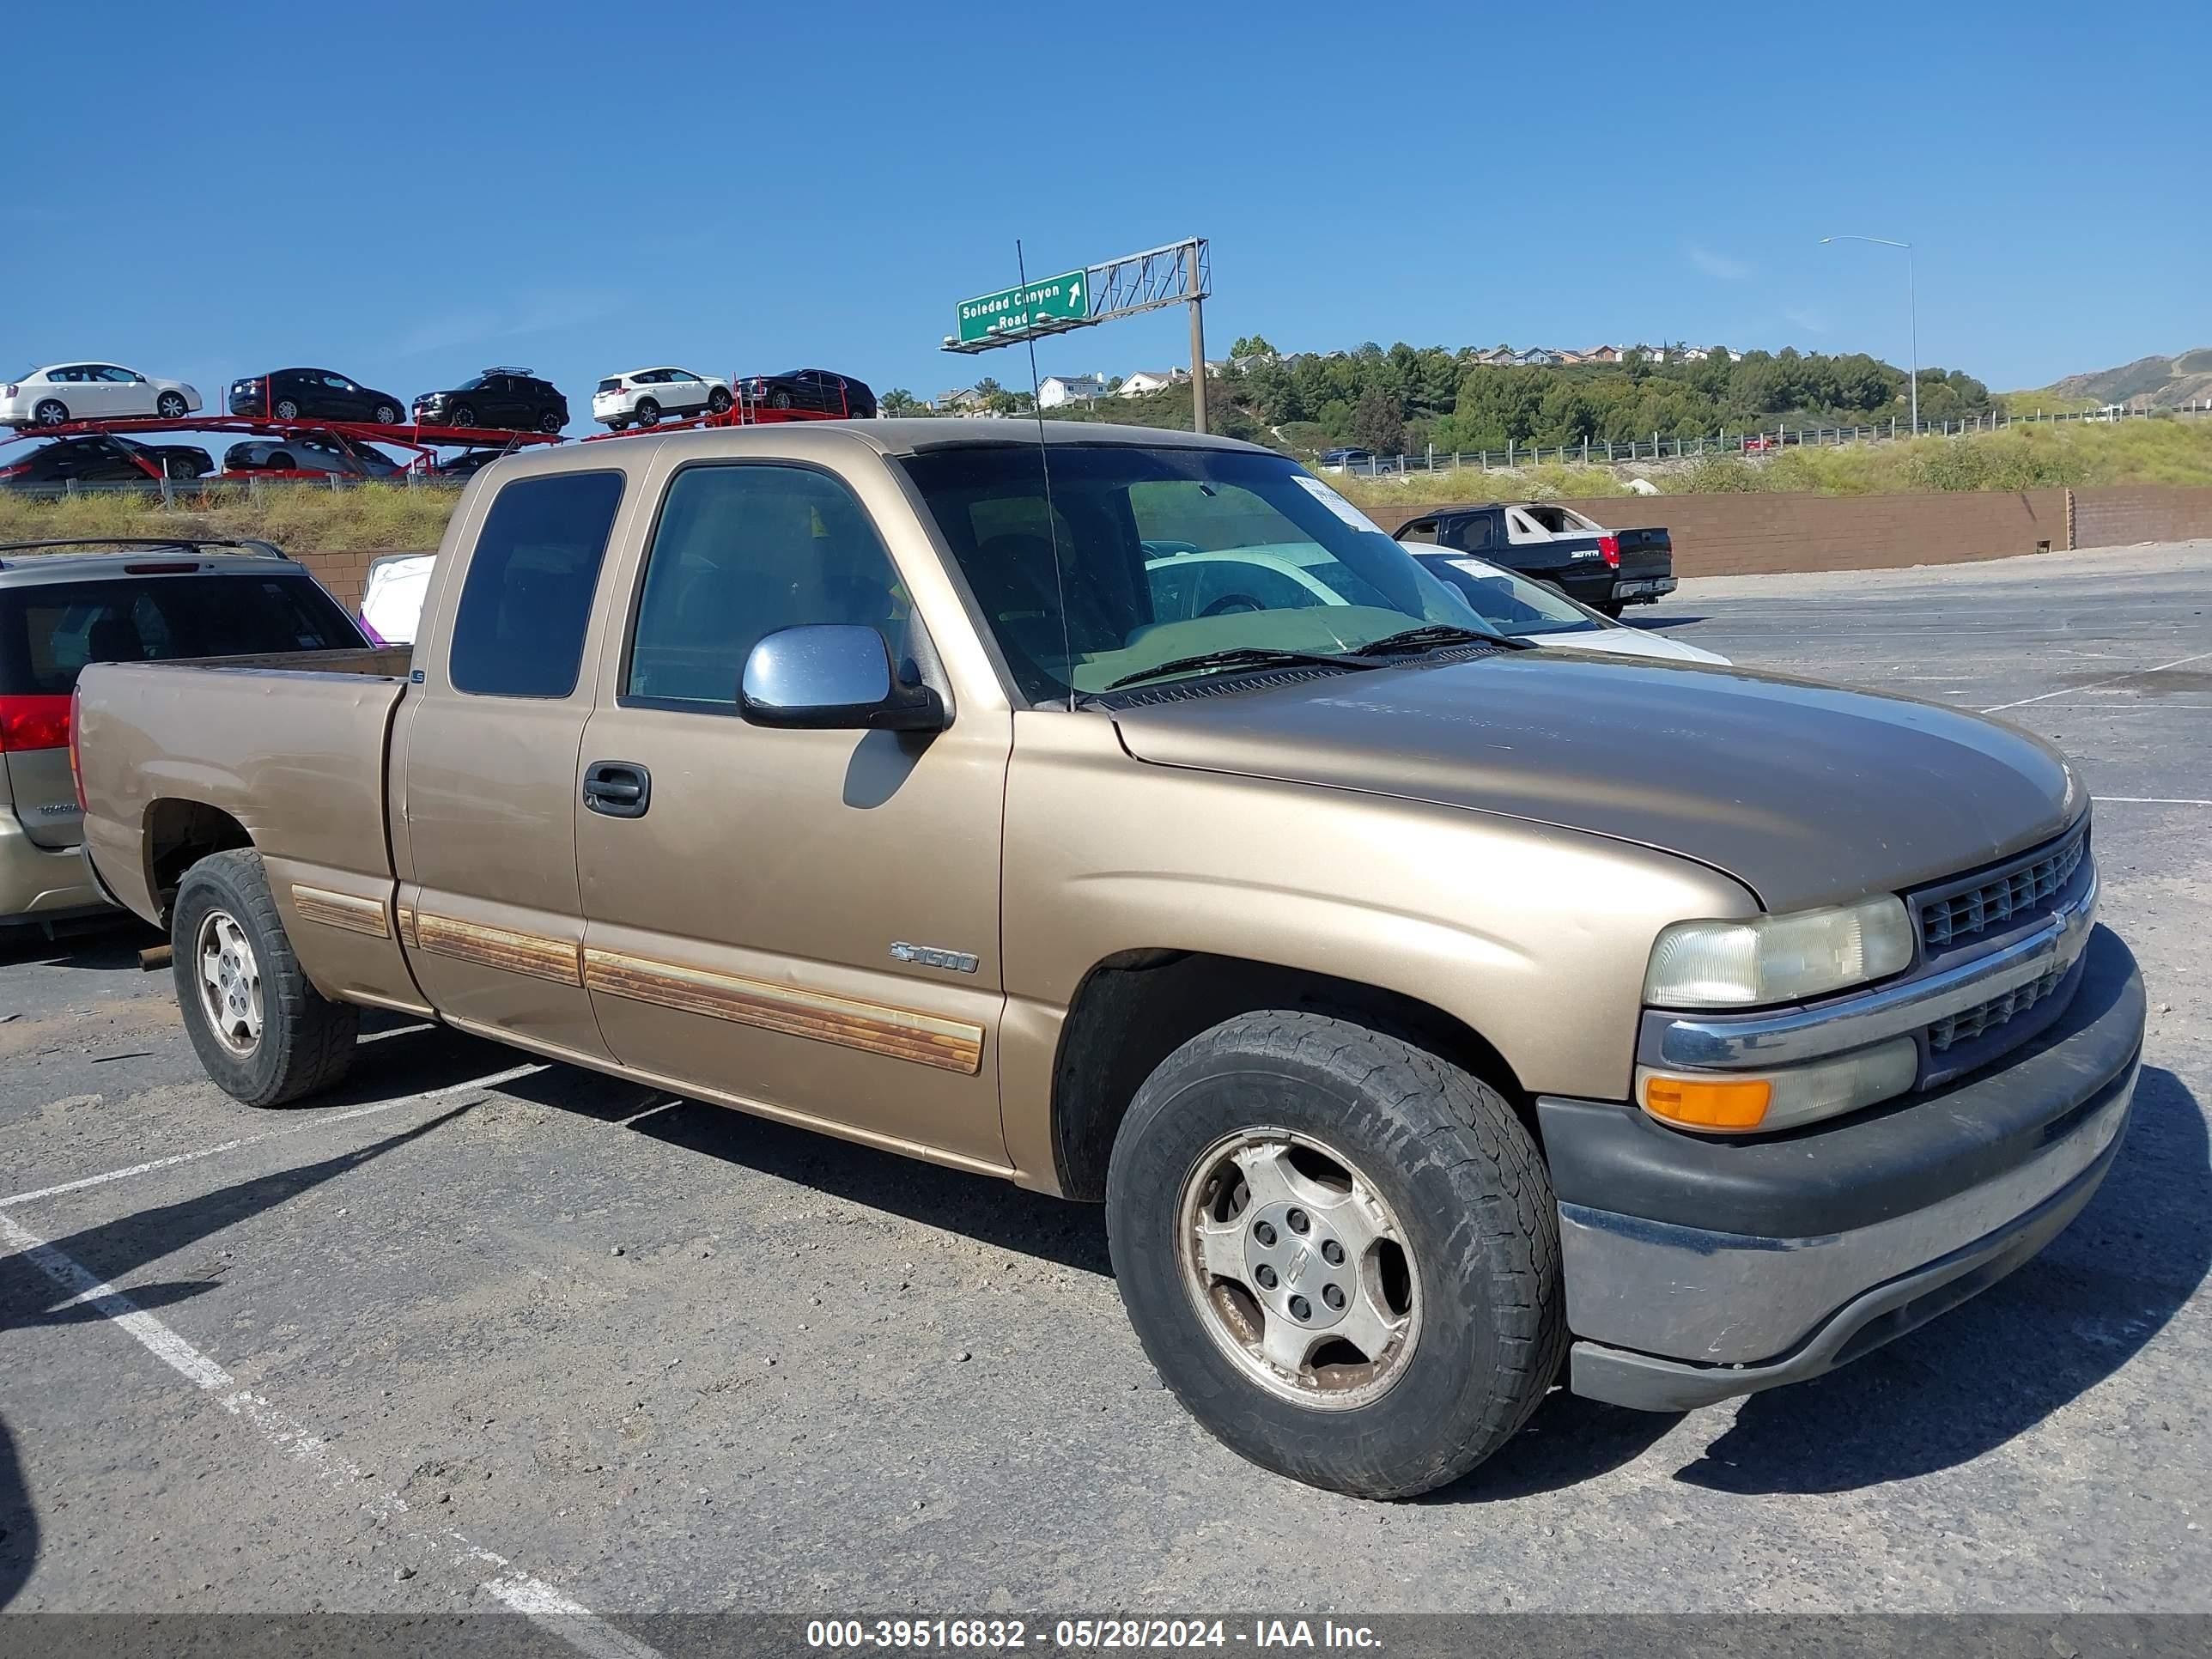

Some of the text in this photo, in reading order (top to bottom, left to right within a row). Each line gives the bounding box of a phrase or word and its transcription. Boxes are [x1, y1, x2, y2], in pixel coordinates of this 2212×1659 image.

[963, 285, 1060, 319] Soledad Canyon
[999, 311, 1028, 329] Road
[918, 947, 979, 973] 1500
